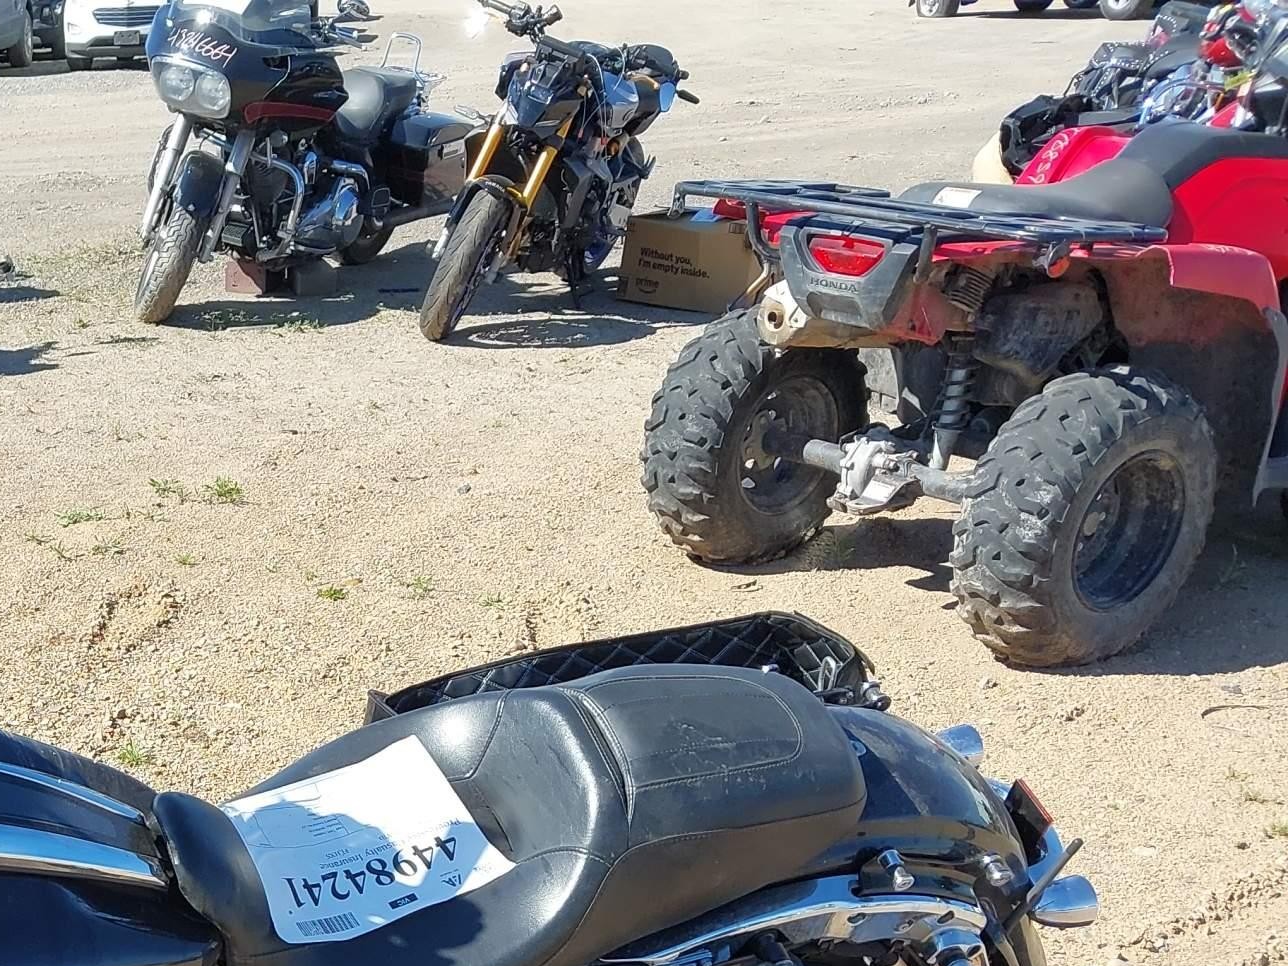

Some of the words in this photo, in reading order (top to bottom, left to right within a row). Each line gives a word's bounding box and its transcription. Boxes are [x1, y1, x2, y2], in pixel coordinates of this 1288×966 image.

[640, 247, 673, 261] Without
[675, 255, 693, 267] you,
[638, 258, 651, 268] I'm
[652, 261, 680, 275] empty
[680, 267, 710, 279] inside.
[635, 278, 659, 289] prime
[810, 278, 859, 294] HONDA
[319, 854, 364, 870] Insurance
[284, 836, 457, 908] 44984241
